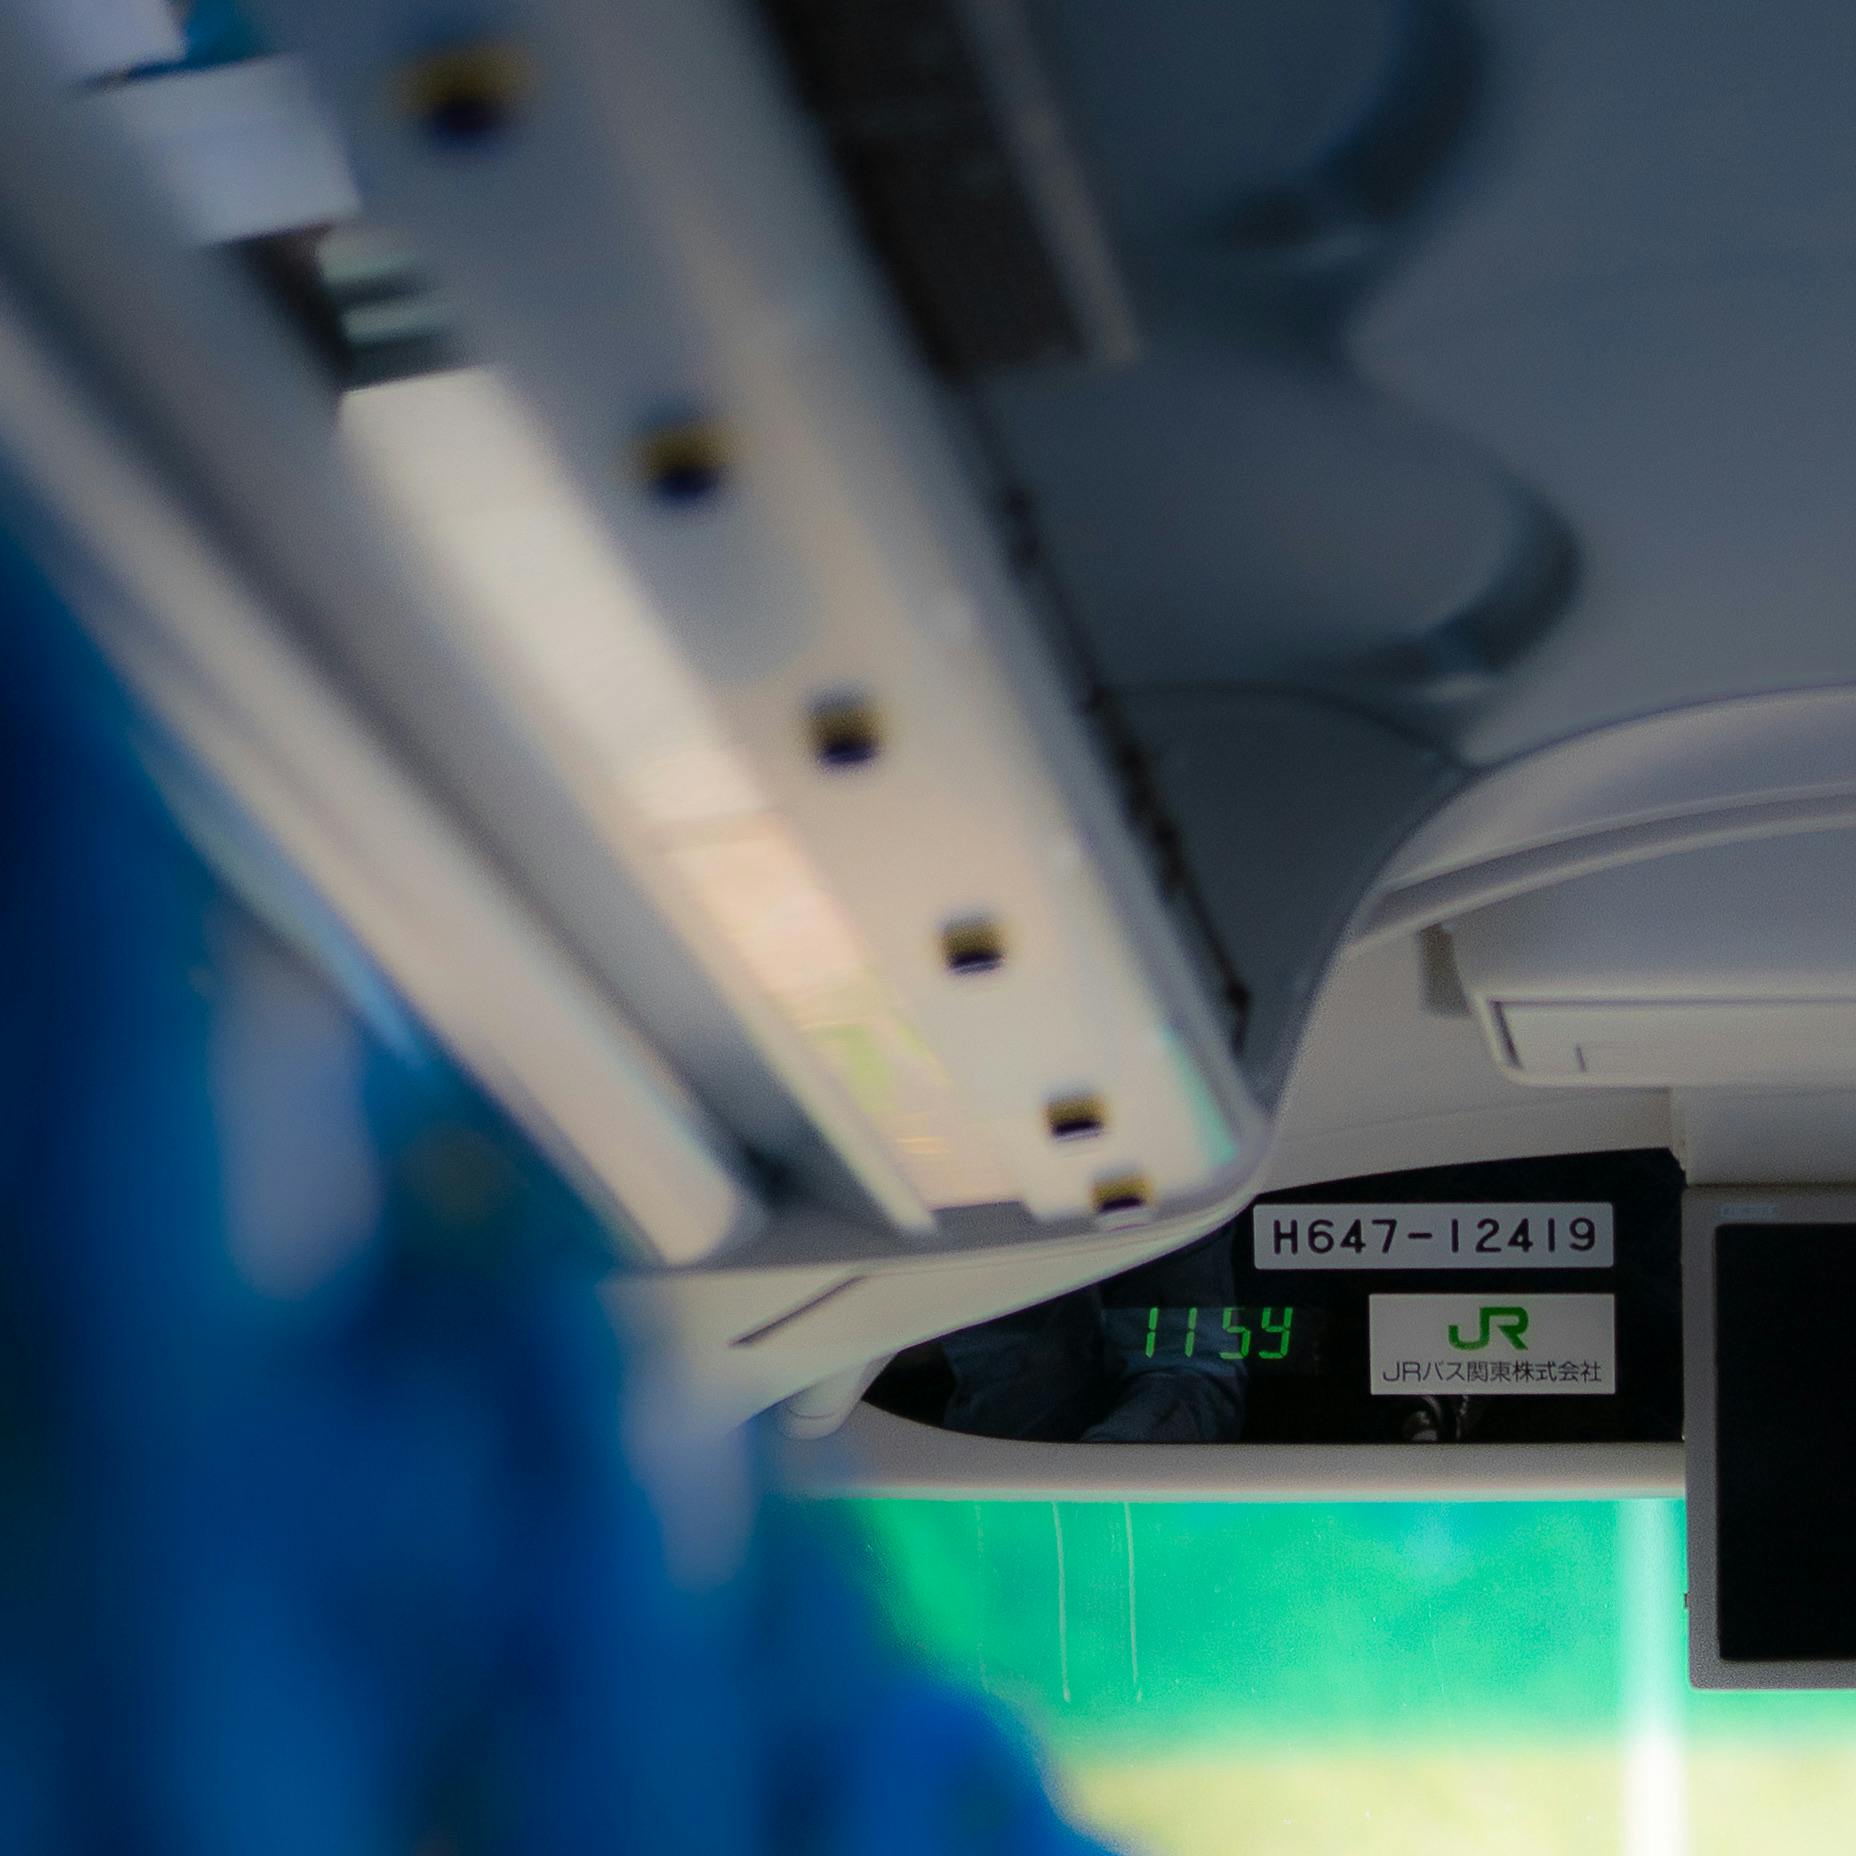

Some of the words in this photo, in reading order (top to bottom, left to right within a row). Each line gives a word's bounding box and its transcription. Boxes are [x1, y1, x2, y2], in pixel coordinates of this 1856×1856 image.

[1272, 1217, 1596, 1254] H647-12419
[1448, 1306, 1529, 1350] JR
[1382, 1360, 1602, 1383] JRバス関東株式会社
